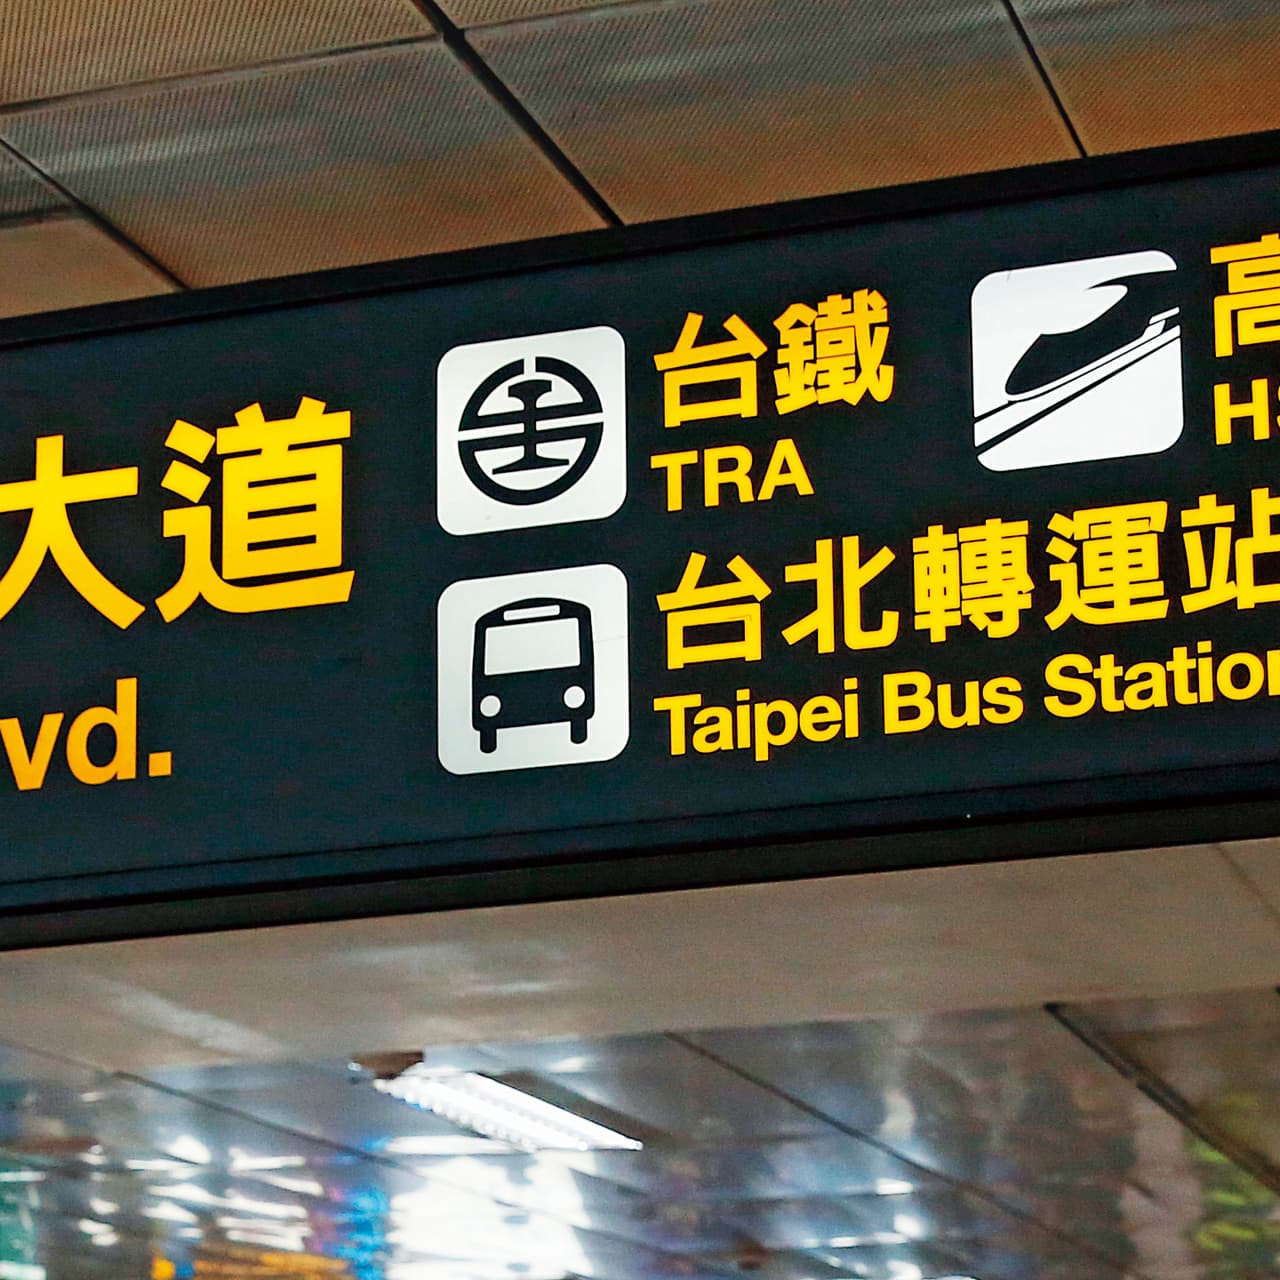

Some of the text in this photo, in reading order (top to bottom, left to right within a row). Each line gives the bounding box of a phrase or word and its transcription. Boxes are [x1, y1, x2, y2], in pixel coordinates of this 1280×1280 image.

[652, 287, 896, 428] 台鐵
[650, 438, 816, 512] TRA
[653, 677, 860, 762] Taipei
[882, 670, 1024, 735] Bus
